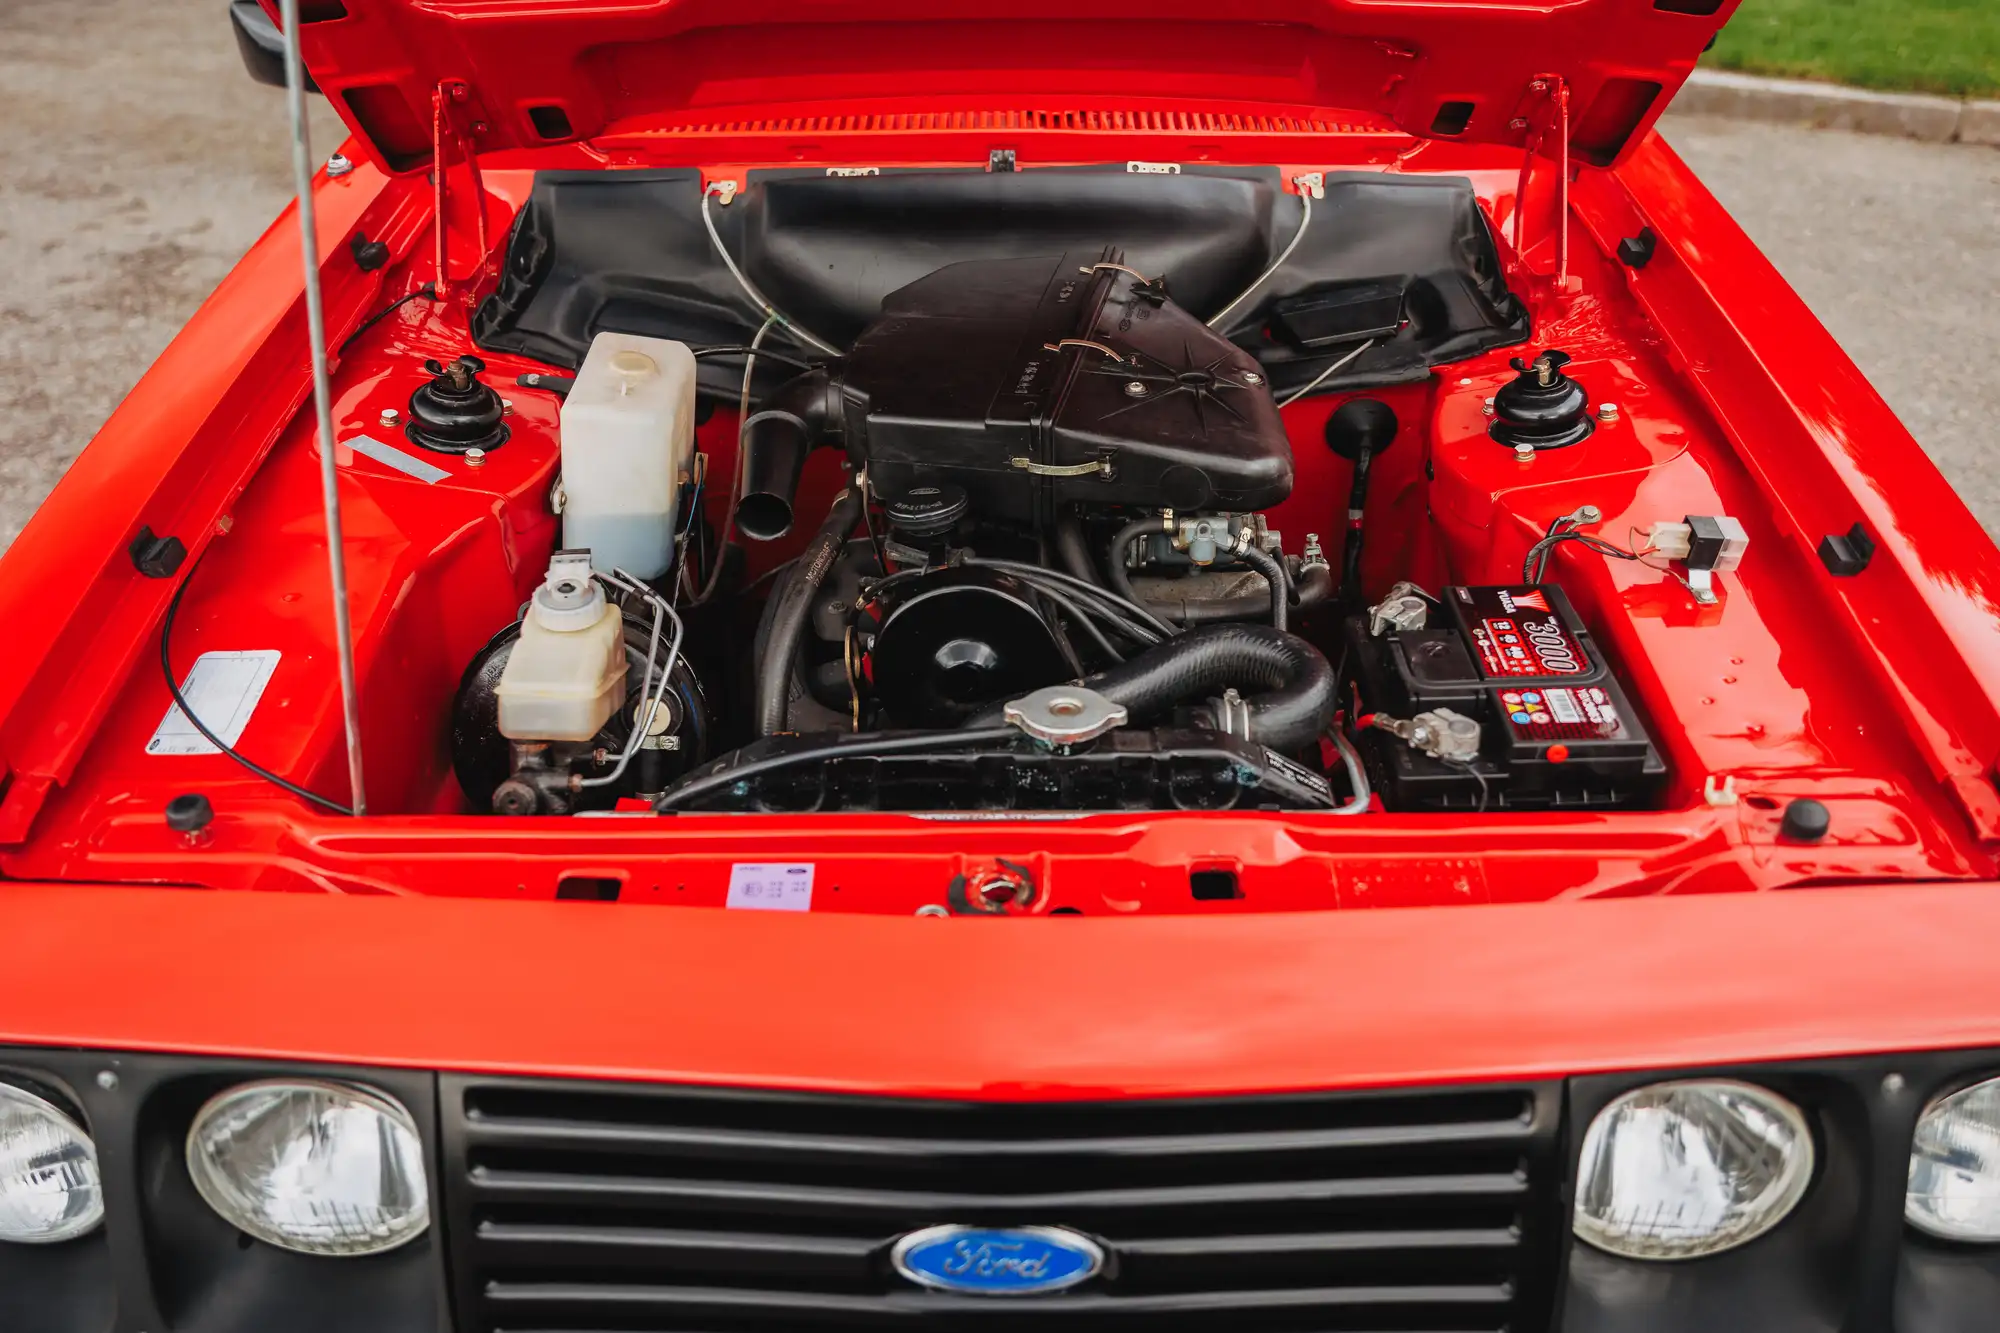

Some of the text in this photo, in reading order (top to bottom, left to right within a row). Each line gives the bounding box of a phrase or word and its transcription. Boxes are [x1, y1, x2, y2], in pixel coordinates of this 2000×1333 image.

[1497, 589, 1517, 614] YUASA
[1499, 621, 1511, 630] 12
[1523, 621, 1579, 672] 3000
[943, 1239, 1051, 1278] Ford
